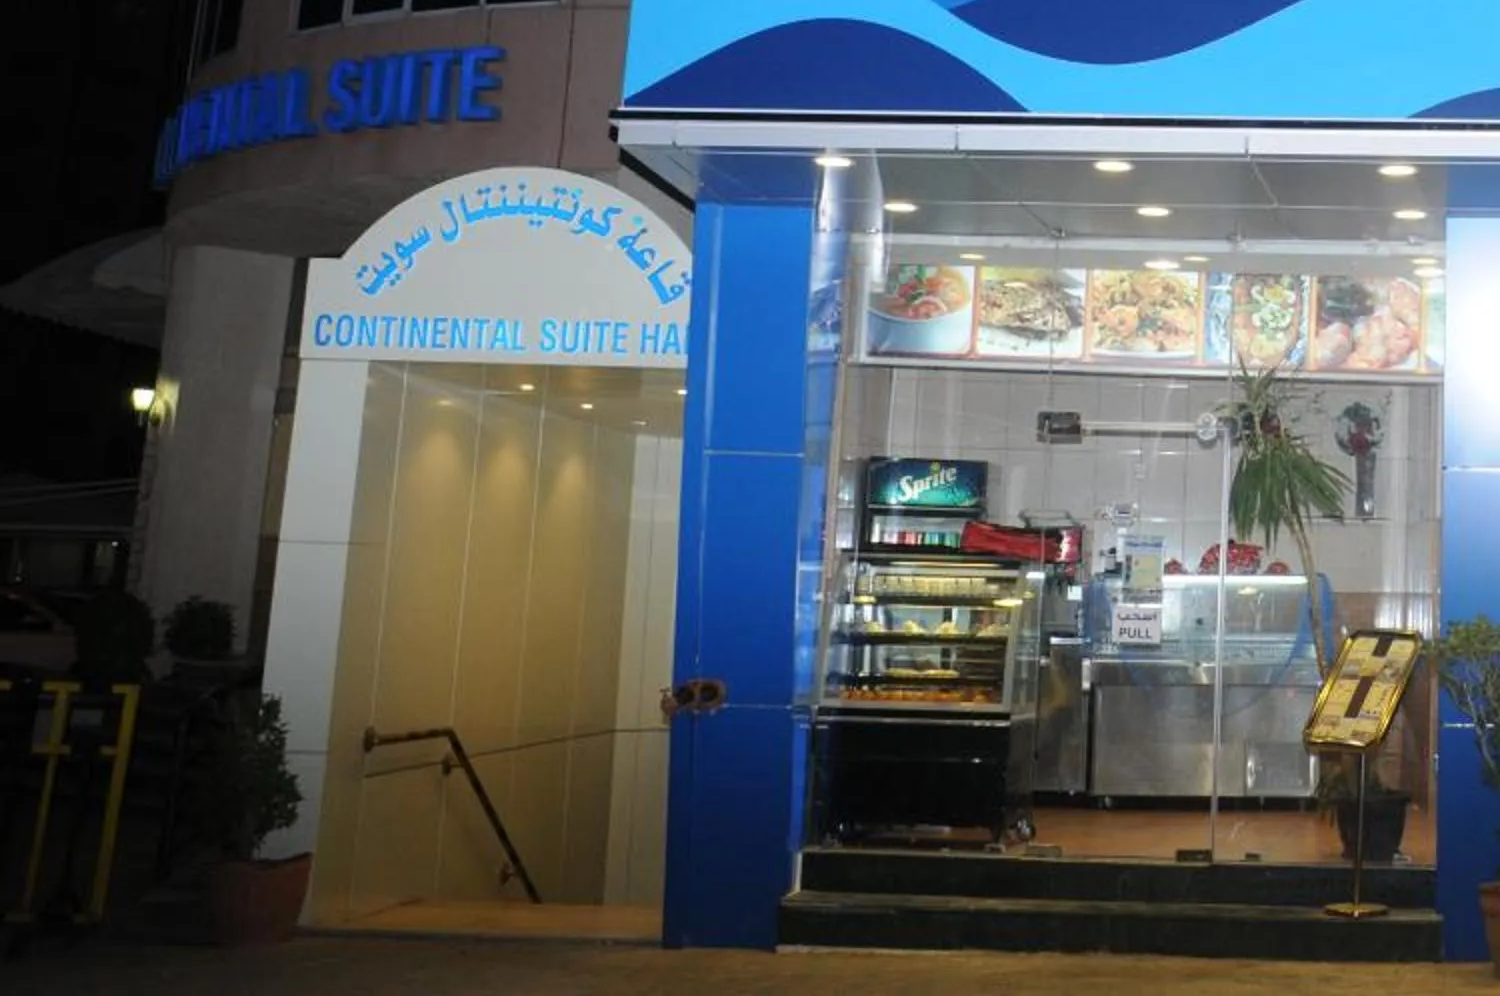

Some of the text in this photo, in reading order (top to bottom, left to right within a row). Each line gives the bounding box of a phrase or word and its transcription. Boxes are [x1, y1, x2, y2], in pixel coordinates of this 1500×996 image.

[324, 45, 507, 133] SUITE
[355, 182, 692, 305] قاعة كونتيننتال سويت
[314, 313, 690, 356] CONTINENTAL SUITE HA
[896, 463, 958, 503] Sprite
[1118, 627, 1153, 639] PULL
